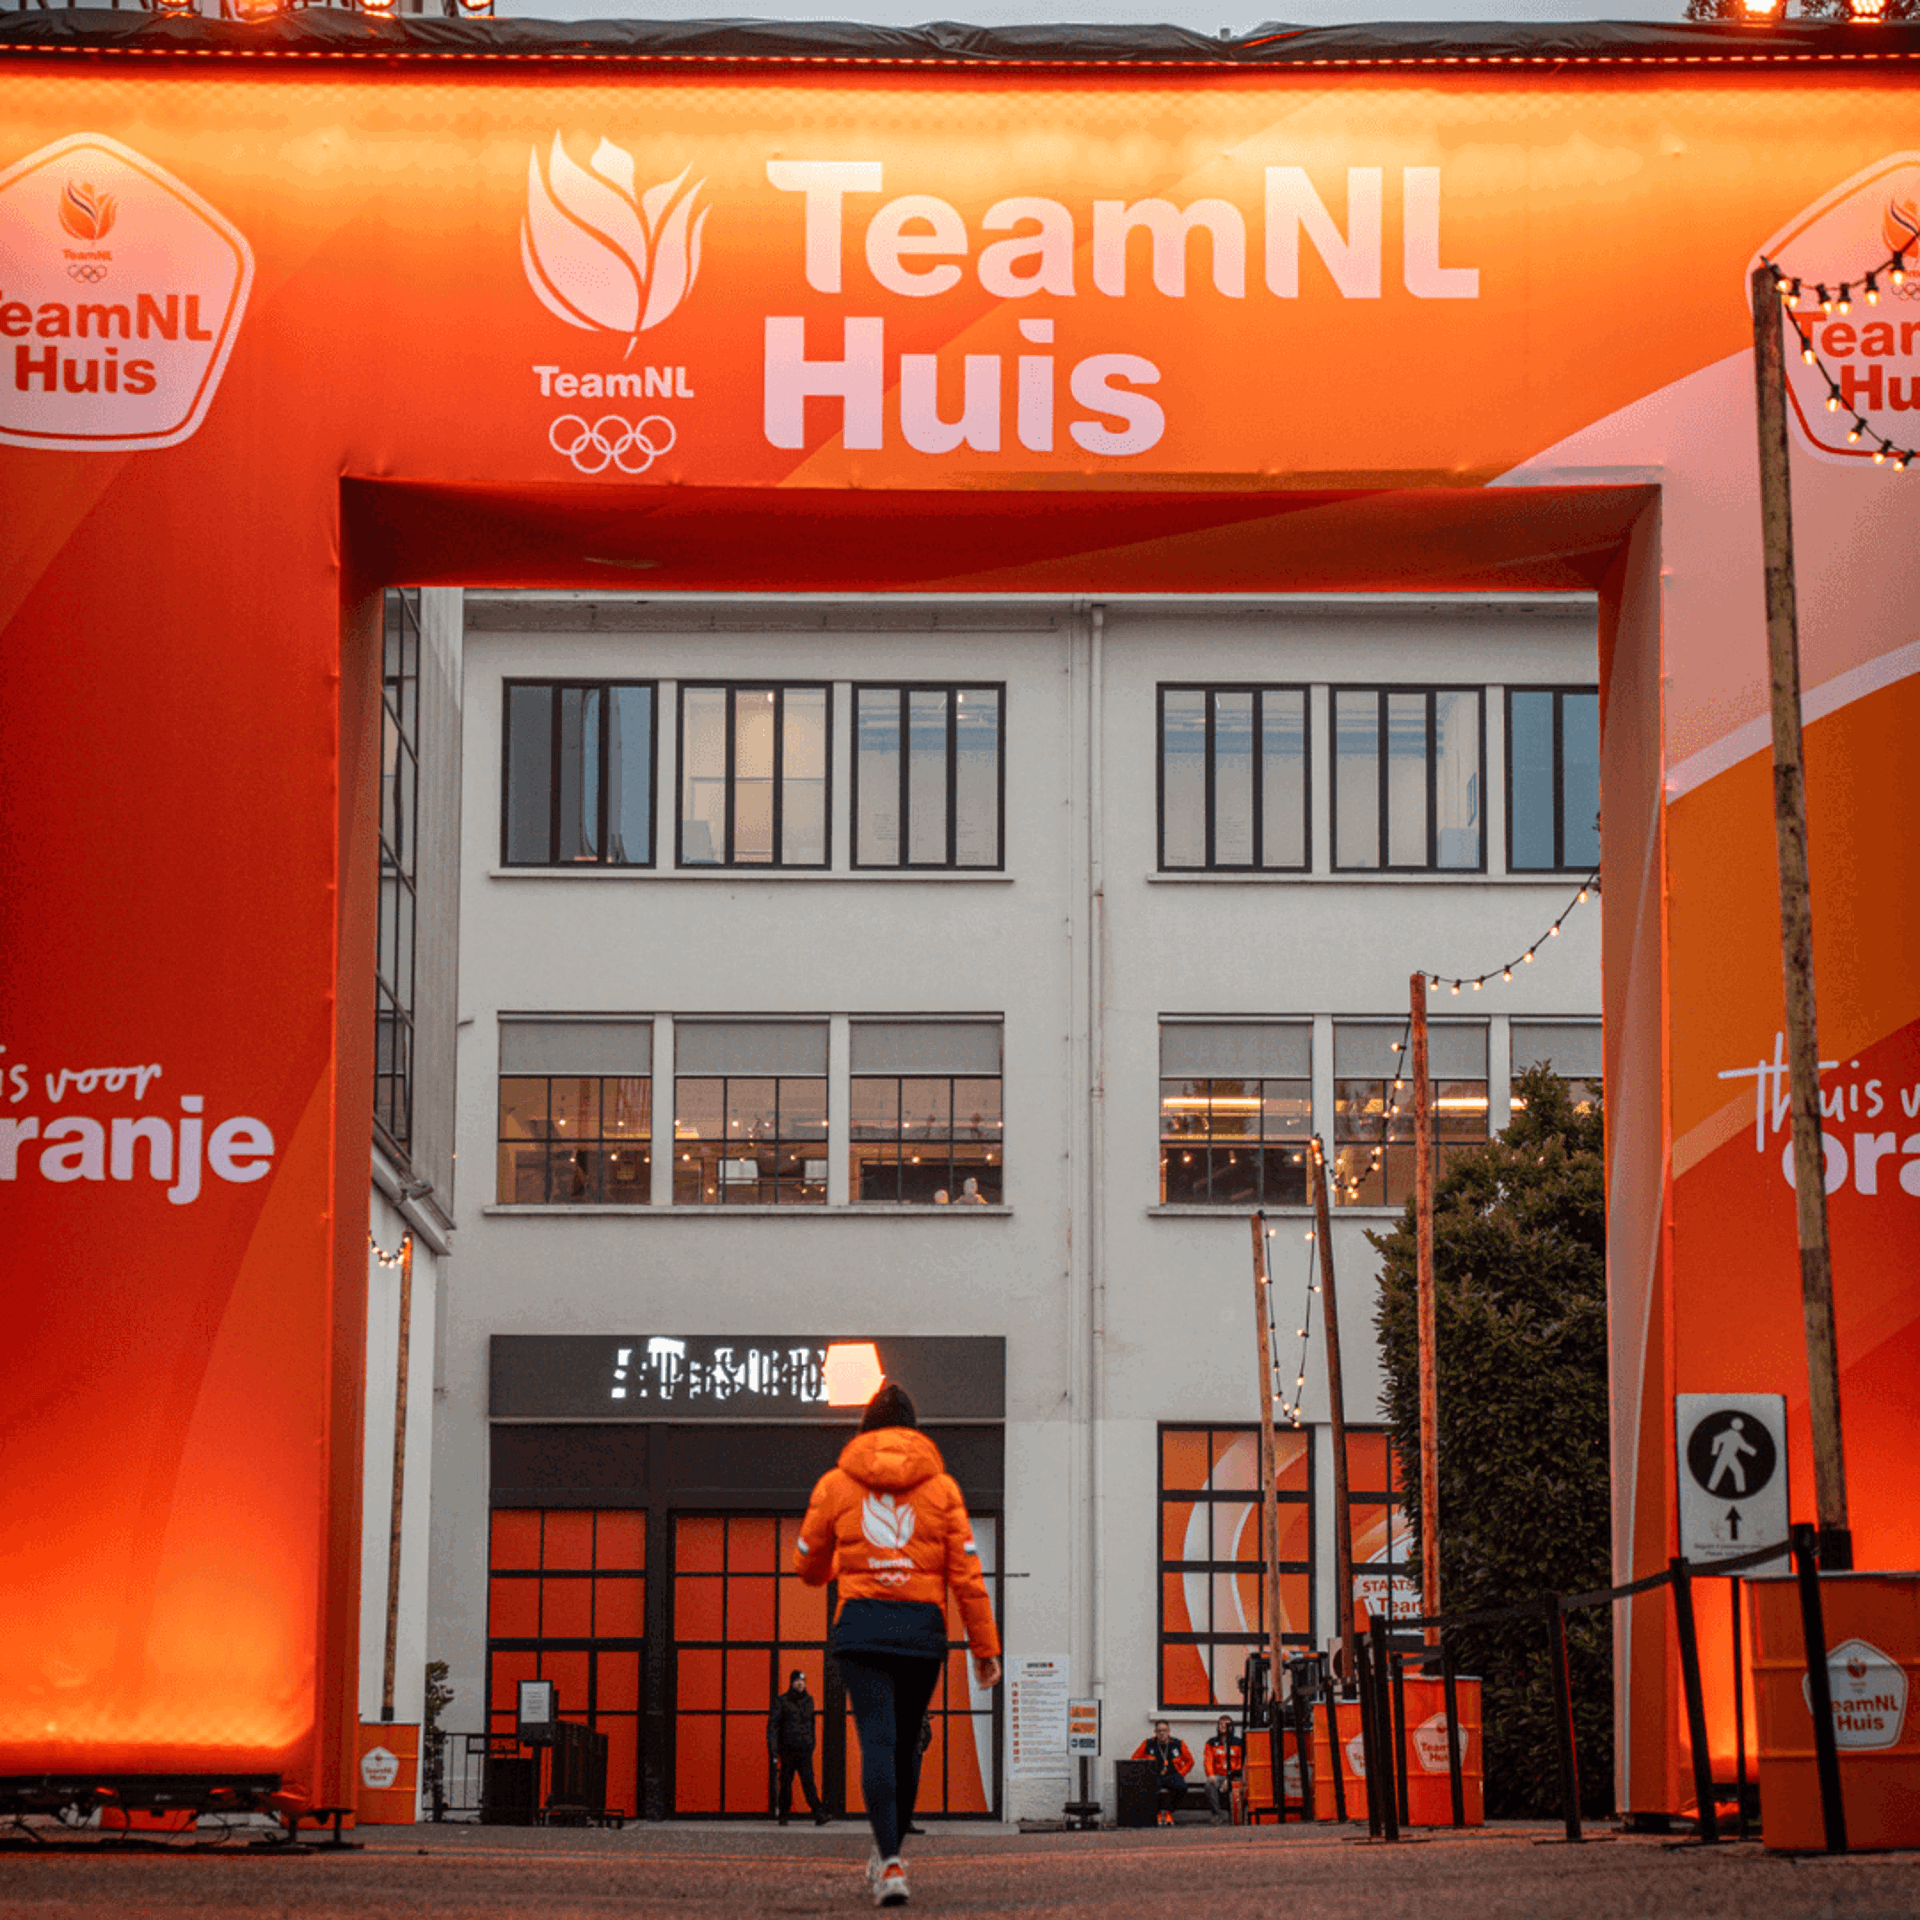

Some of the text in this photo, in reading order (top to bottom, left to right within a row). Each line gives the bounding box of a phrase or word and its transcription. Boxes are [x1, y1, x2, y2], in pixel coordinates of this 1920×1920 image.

[765, 161, 1480, 299] TeamNL
[0, 288, 213, 341] eamNL
[15, 344, 157, 395] Huis
[531, 365, 695, 399] TeamNL
[764, 316, 1166, 456] Huis
[45, 1063, 163, 1103] voor
[1831, 1695, 1898, 1714] eamNL
[1836, 1714, 1885, 1732] Huis
